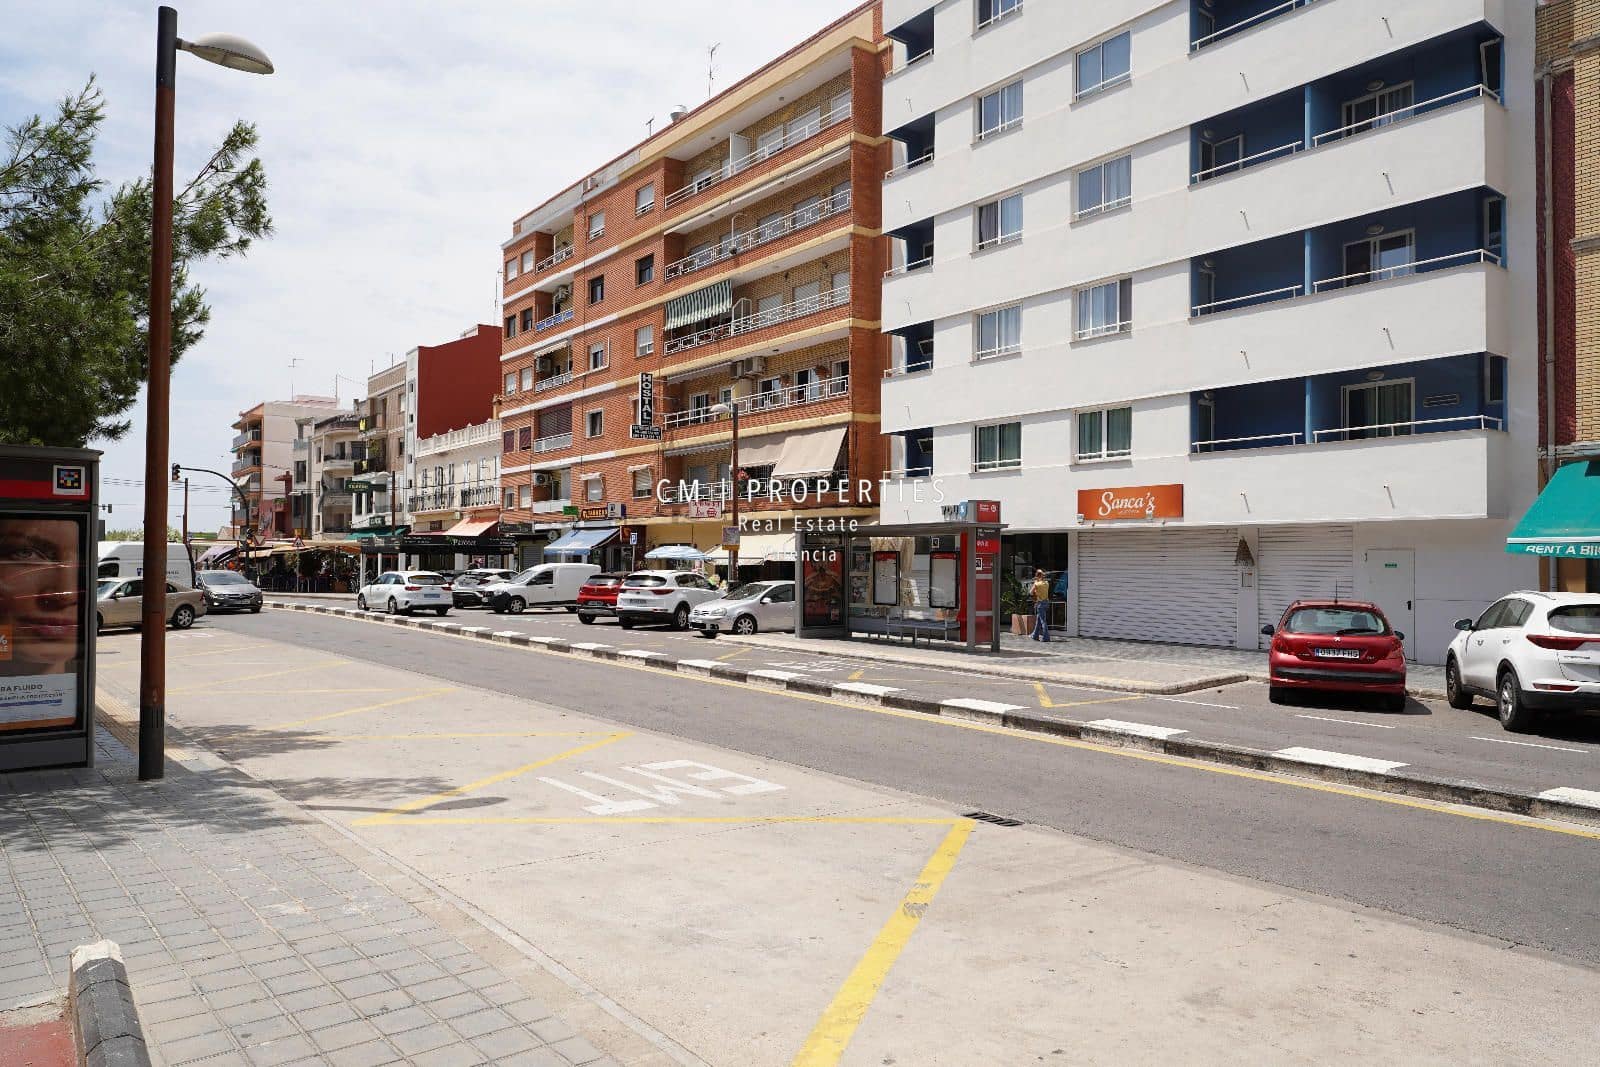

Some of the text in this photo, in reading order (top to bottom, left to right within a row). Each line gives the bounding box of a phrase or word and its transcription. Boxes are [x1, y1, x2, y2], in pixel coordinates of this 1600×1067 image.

[642, 374, 652, 420] HOSTAL
[1098, 491, 1156, 516] Sanca's
[1525, 545, 1563, 554] RENT
[1565, 545, 1576, 555] A
[13, 684, 43, 692] FLUIDO
